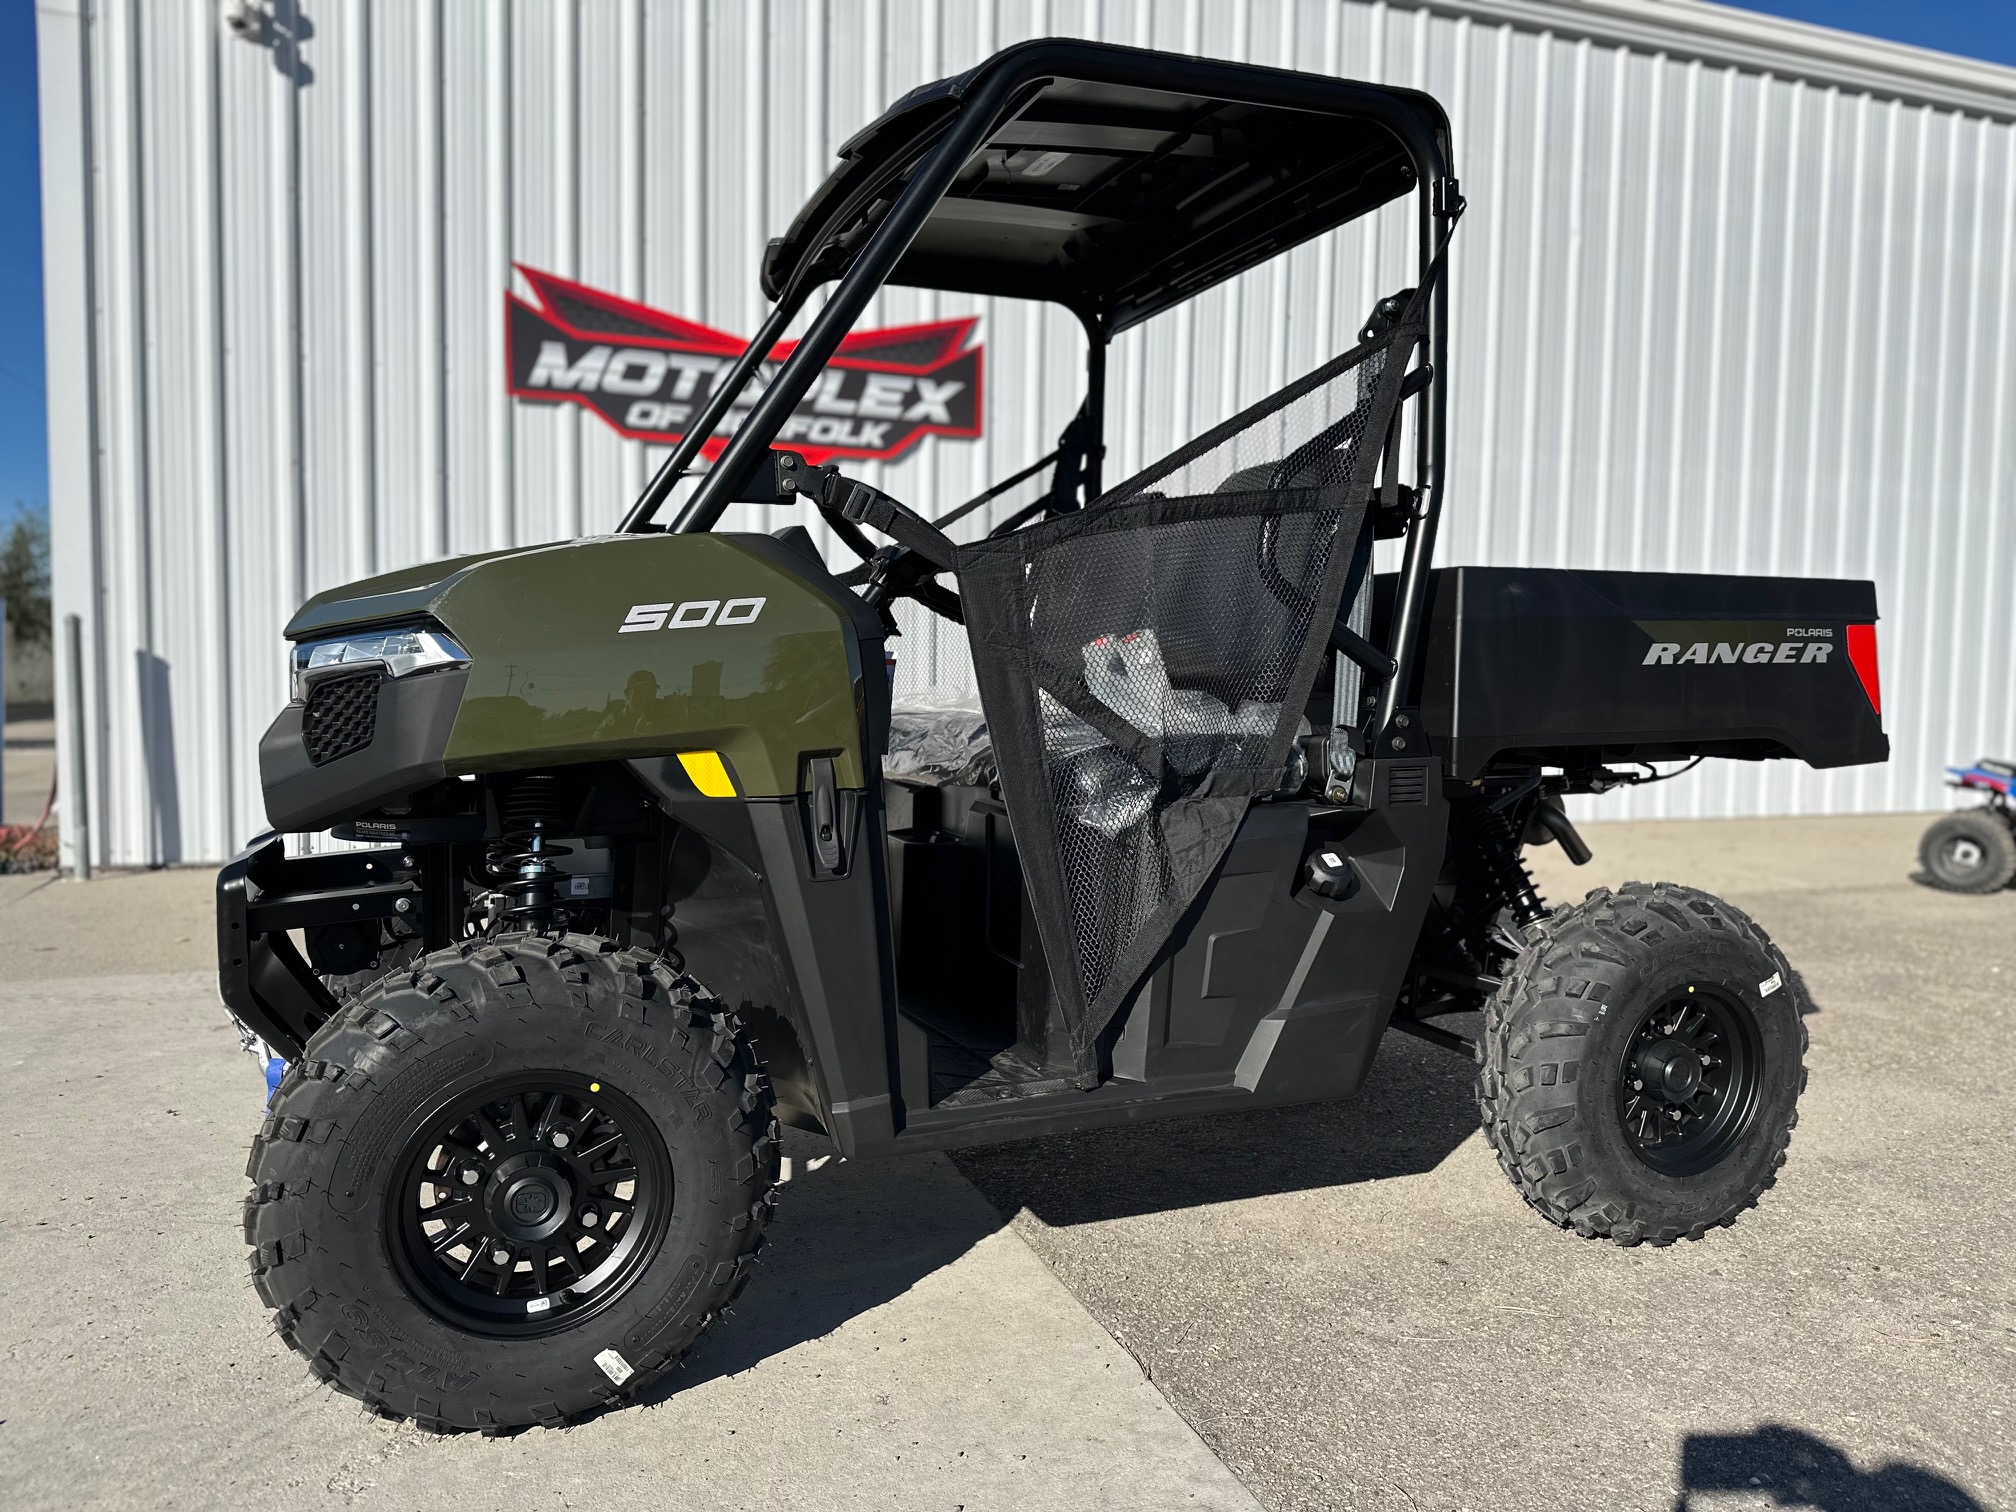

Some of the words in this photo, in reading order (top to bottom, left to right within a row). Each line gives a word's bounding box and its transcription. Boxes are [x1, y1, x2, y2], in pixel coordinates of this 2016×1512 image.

[625, 401, 692, 430] OF
[617, 597, 767, 634] 500
[1787, 628, 1833, 637] POLARIS
[1642, 642, 1833, 665] RANGER
[355, 821, 396, 830] POLARIS
[584, 1021, 713, 1124] CARLSTAR
